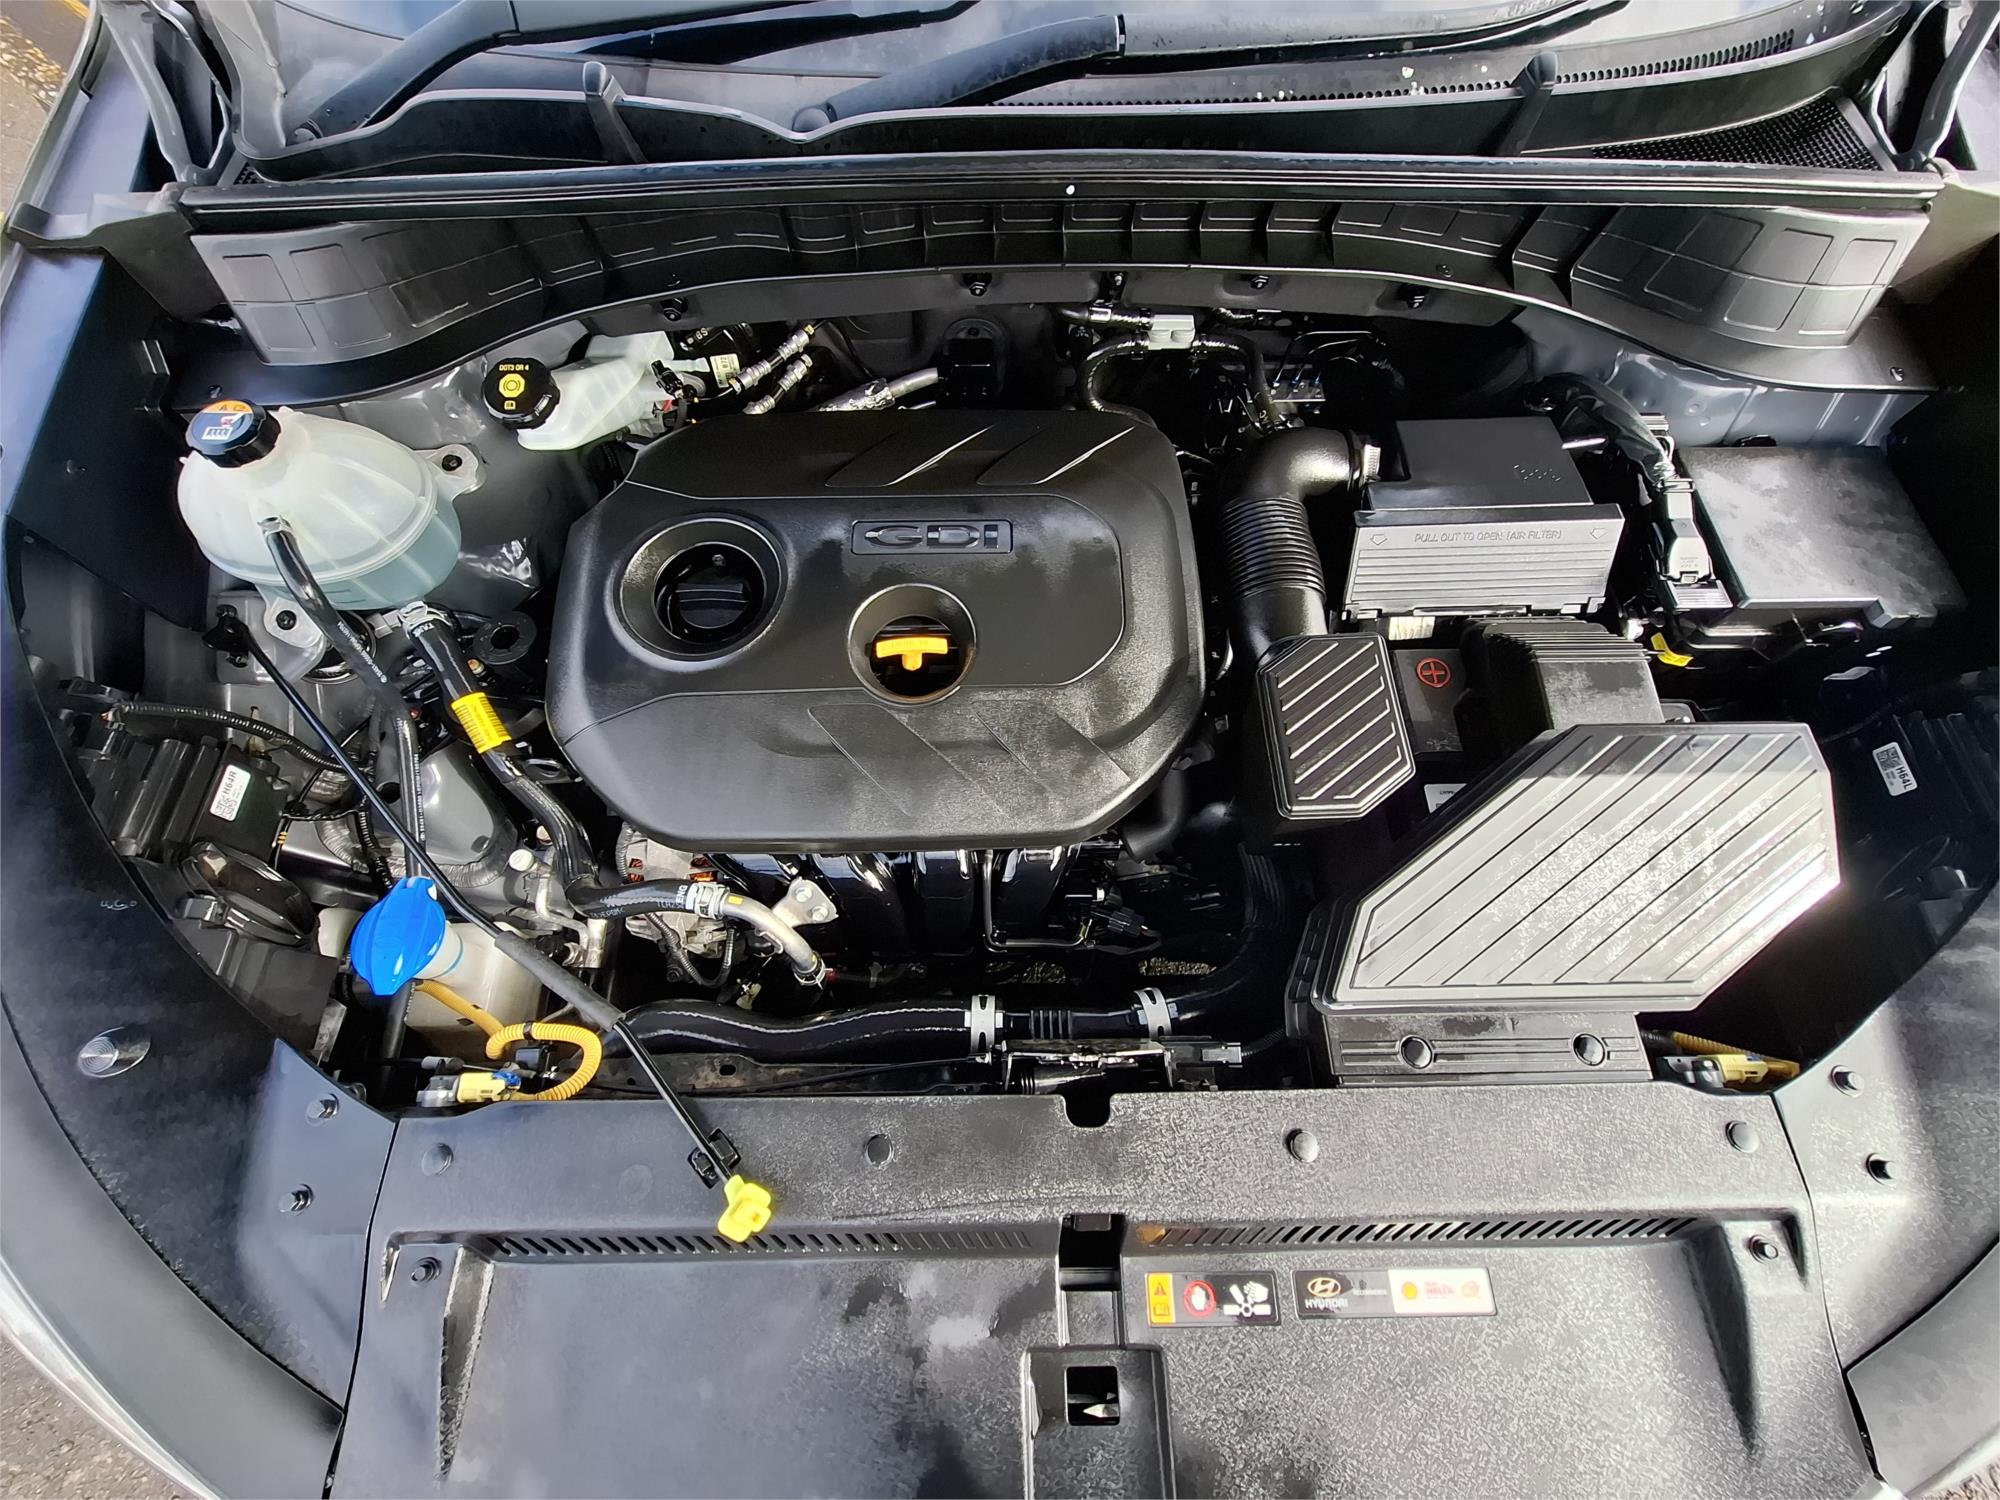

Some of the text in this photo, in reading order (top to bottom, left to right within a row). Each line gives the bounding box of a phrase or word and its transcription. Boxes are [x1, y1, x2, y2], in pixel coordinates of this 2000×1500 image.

[864, 525, 999, 549] GDI
[1414, 532, 1439, 543] PULL
[1440, 531, 1460, 542] OUT
[1463, 531, 1475, 541] TO
[1476, 530, 1503, 541] OPEN
[1896, 766, 1913, 790] H64L
